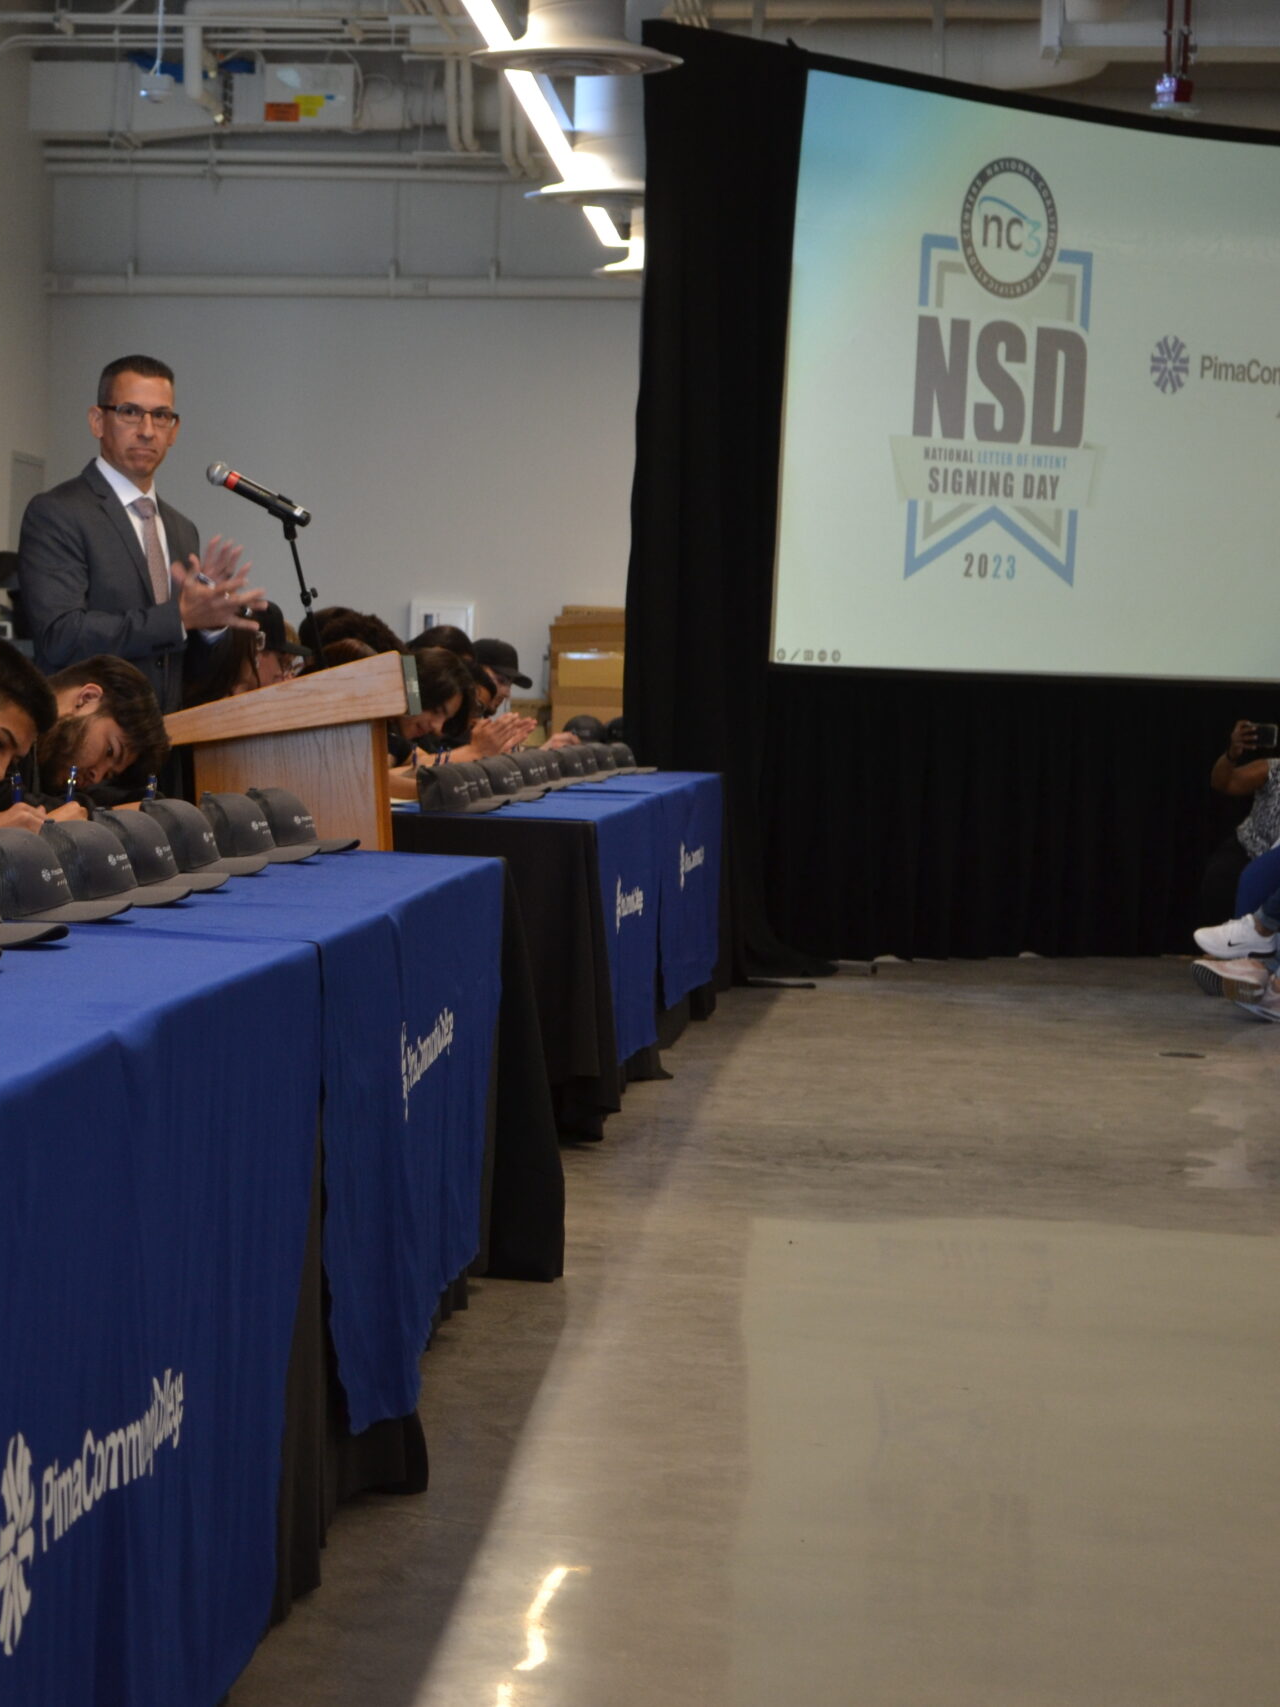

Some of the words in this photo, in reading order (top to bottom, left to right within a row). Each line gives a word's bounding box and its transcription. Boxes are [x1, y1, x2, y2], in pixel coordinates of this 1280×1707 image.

[985, 160, 1037, 181] NATIONAL
[982, 213, 1041, 258] nc3
[912, 314, 1088, 448] NSD
[923, 447, 974, 463] NATIONAL
[977, 451, 1013, 466] LETTER
[1017, 453, 1029, 467] OF
[1032, 455, 1067, 469] INTENT
[928, 466, 1015, 499] SIGNING
[1022, 473, 1060, 501] DAY
[964, 552, 1016, 580] 2023
